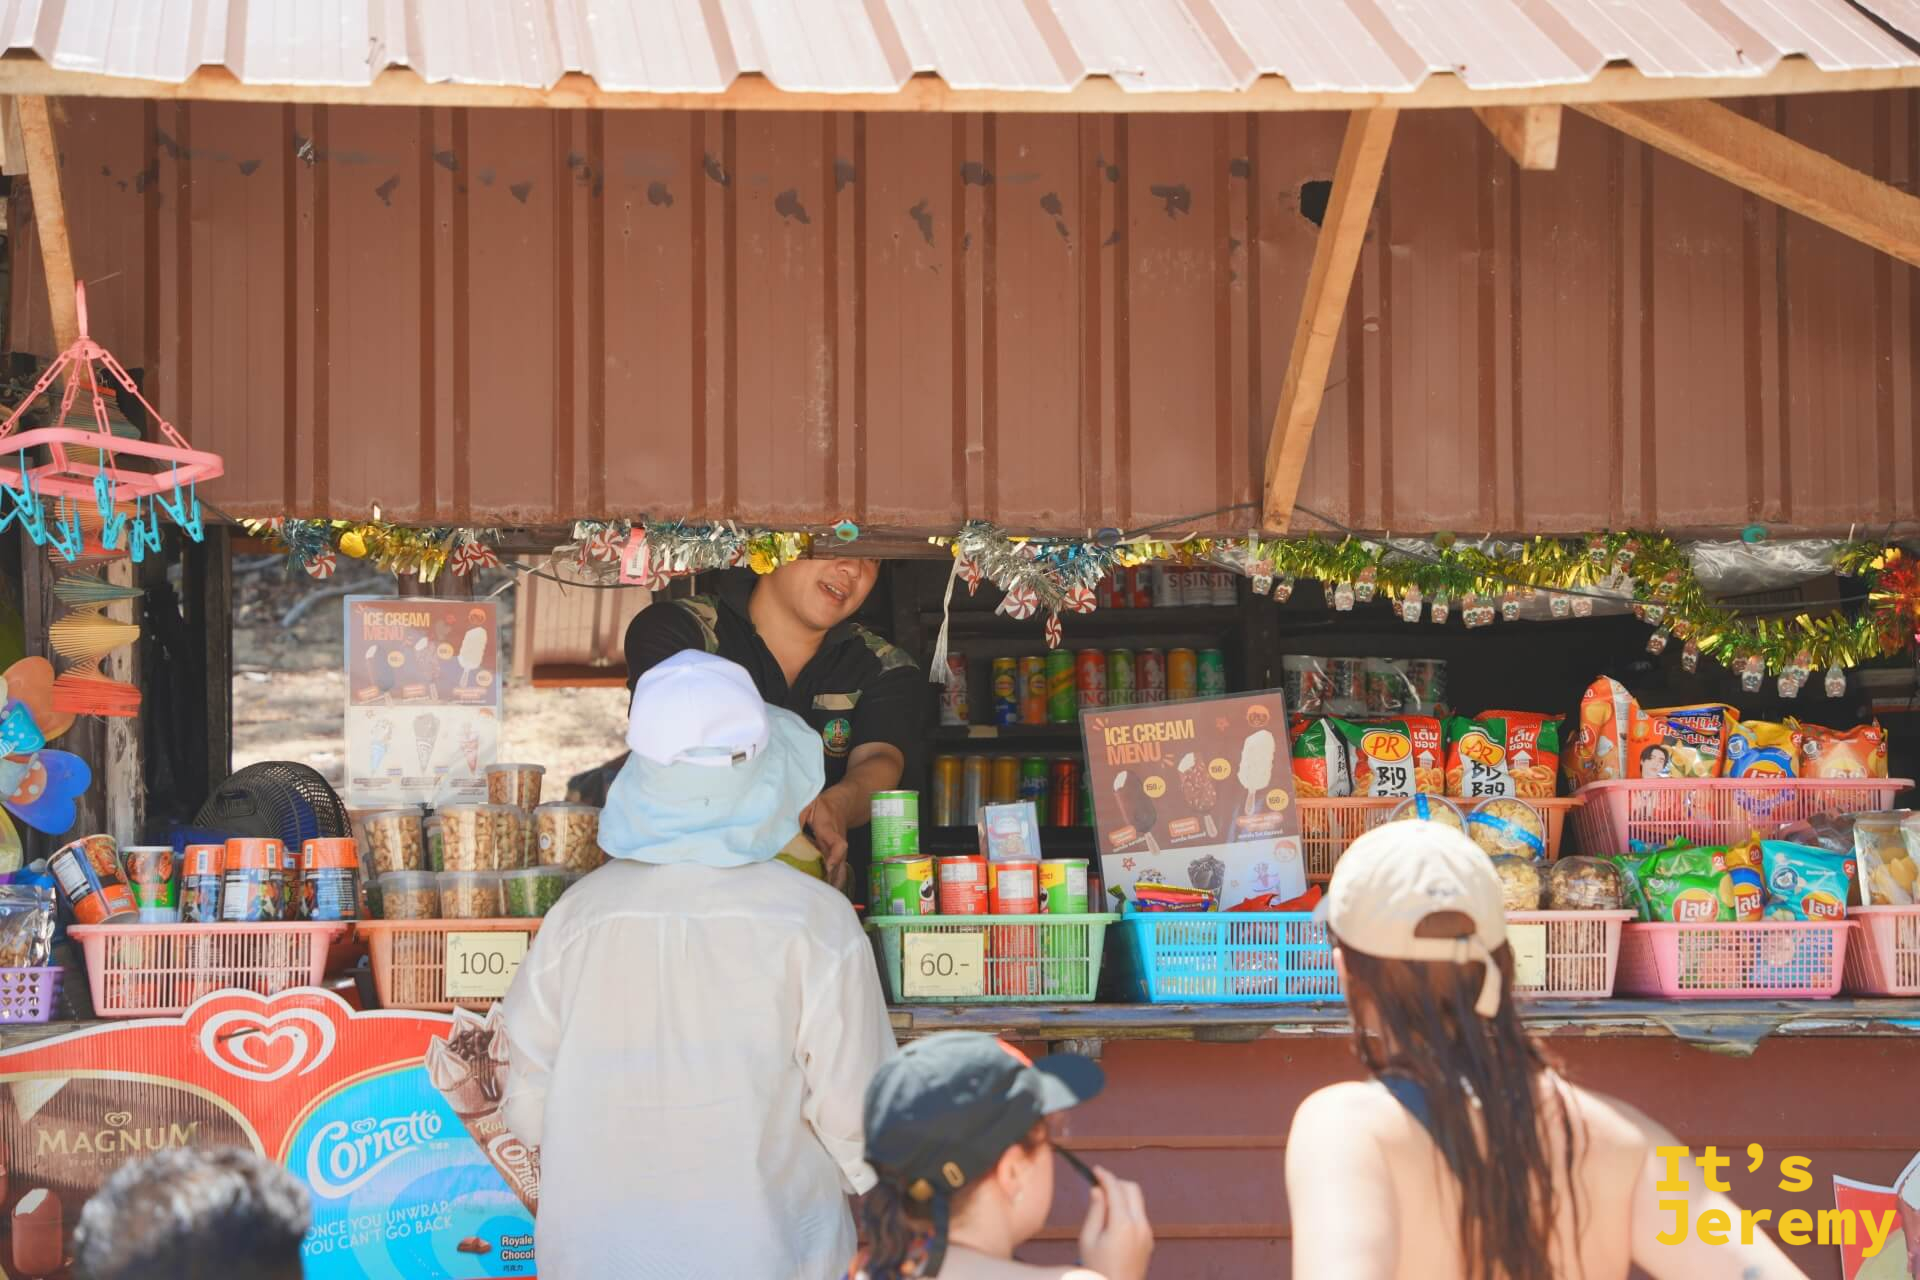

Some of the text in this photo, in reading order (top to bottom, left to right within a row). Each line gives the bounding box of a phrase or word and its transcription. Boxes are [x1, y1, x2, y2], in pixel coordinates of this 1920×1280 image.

[363, 612, 430, 627] ICE CREAM
[363, 625, 405, 641] MENU
[1103, 719, 1195, 746] ICE CREAM
[1106, 741, 1162, 767] MENU
[1369, 736, 1402, 758] PR
[1376, 766, 1407, 790] Big
[459, 951, 520, 975] 100.-
[919, 952, 970, 977] 60.-
[35, 1121, 199, 1156] MAGNUM
[307, 1110, 442, 1200] Cornetto
[302, 1215, 451, 1257] YOU CAN'T GO BACK
[304, 1220, 347, 1241] ONCE
[350, 1213, 382, 1230] YOU
[502, 1235, 534, 1248] Royale
